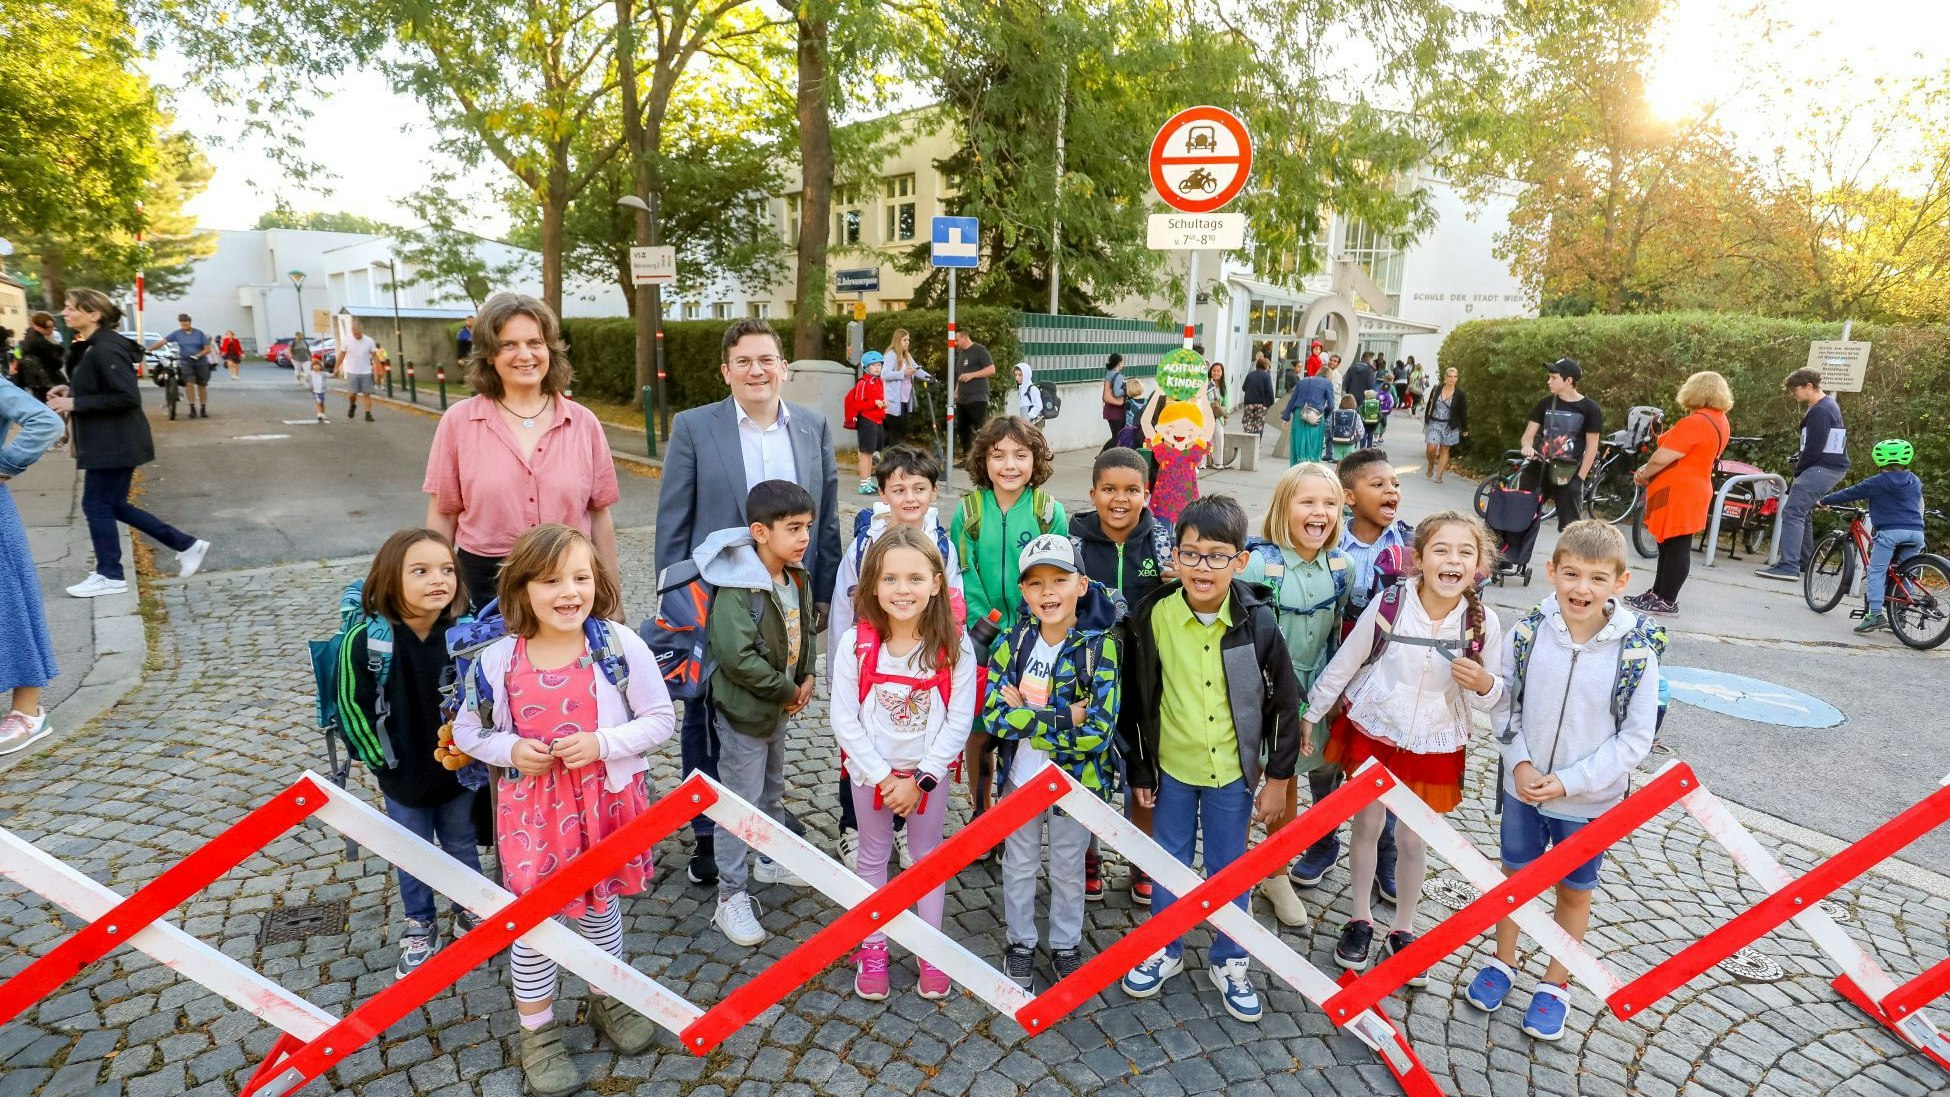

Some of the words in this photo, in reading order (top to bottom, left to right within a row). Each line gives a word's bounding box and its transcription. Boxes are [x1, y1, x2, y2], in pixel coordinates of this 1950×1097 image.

[1168, 218, 1223, 231] Schultags
[1413, 293, 1445, 301] SCHULE
[1450, 293, 1467, 301] DER
[1473, 294, 1499, 302] STADT
[1504, 294, 1524, 302] WIEN
[1163, 363, 1207, 374] ACHTUNG
[1167, 375, 1203, 388] KINDER
[1138, 569, 1158, 577] XBO
